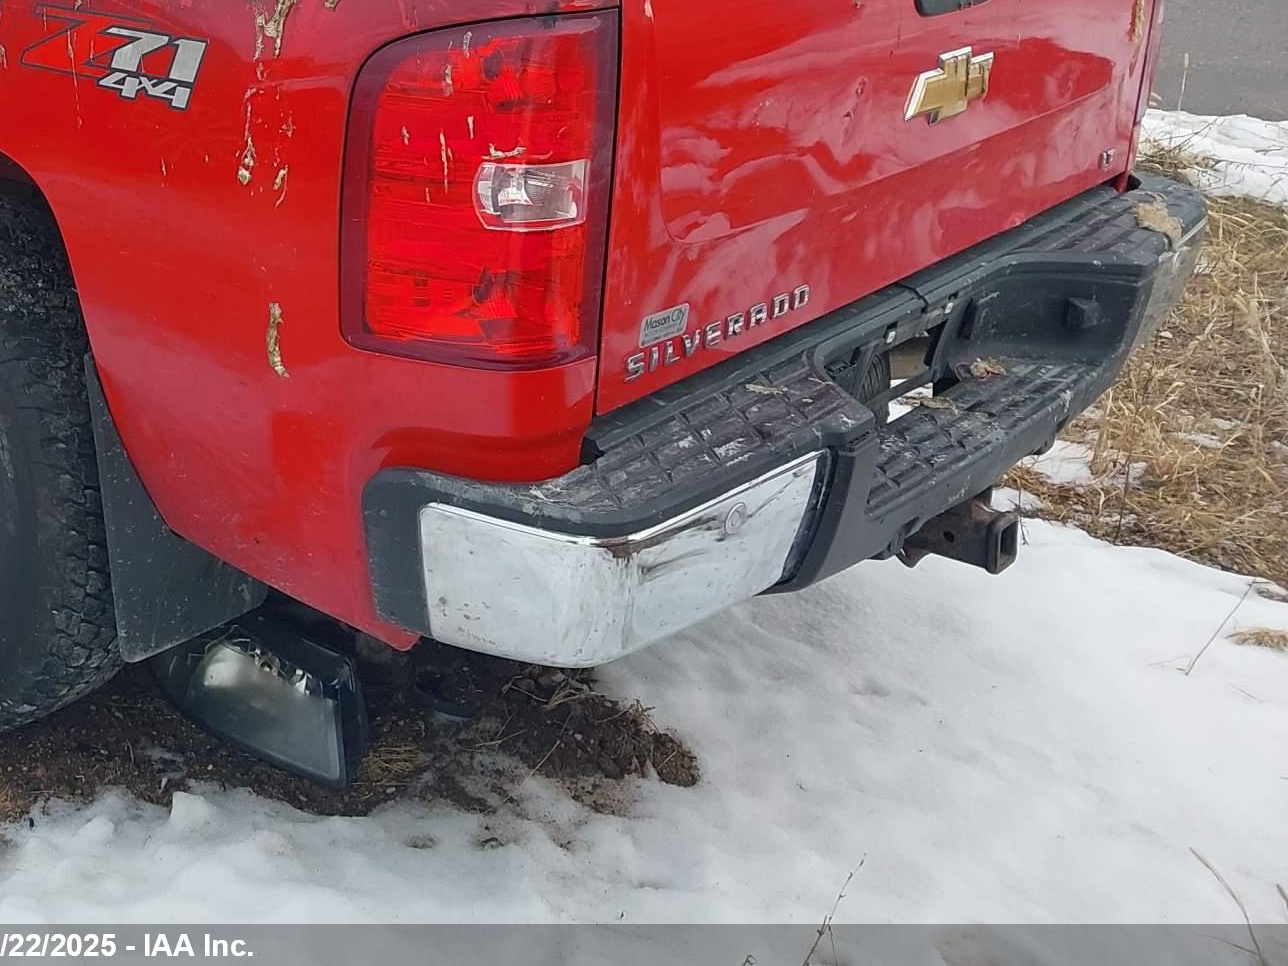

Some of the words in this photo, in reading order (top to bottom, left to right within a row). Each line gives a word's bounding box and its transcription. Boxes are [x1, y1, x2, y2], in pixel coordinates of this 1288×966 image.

[624, 284, 810, 383] SILVERADO
[643, 315, 671, 332] Mason
[671, 308, 687, 326] City
